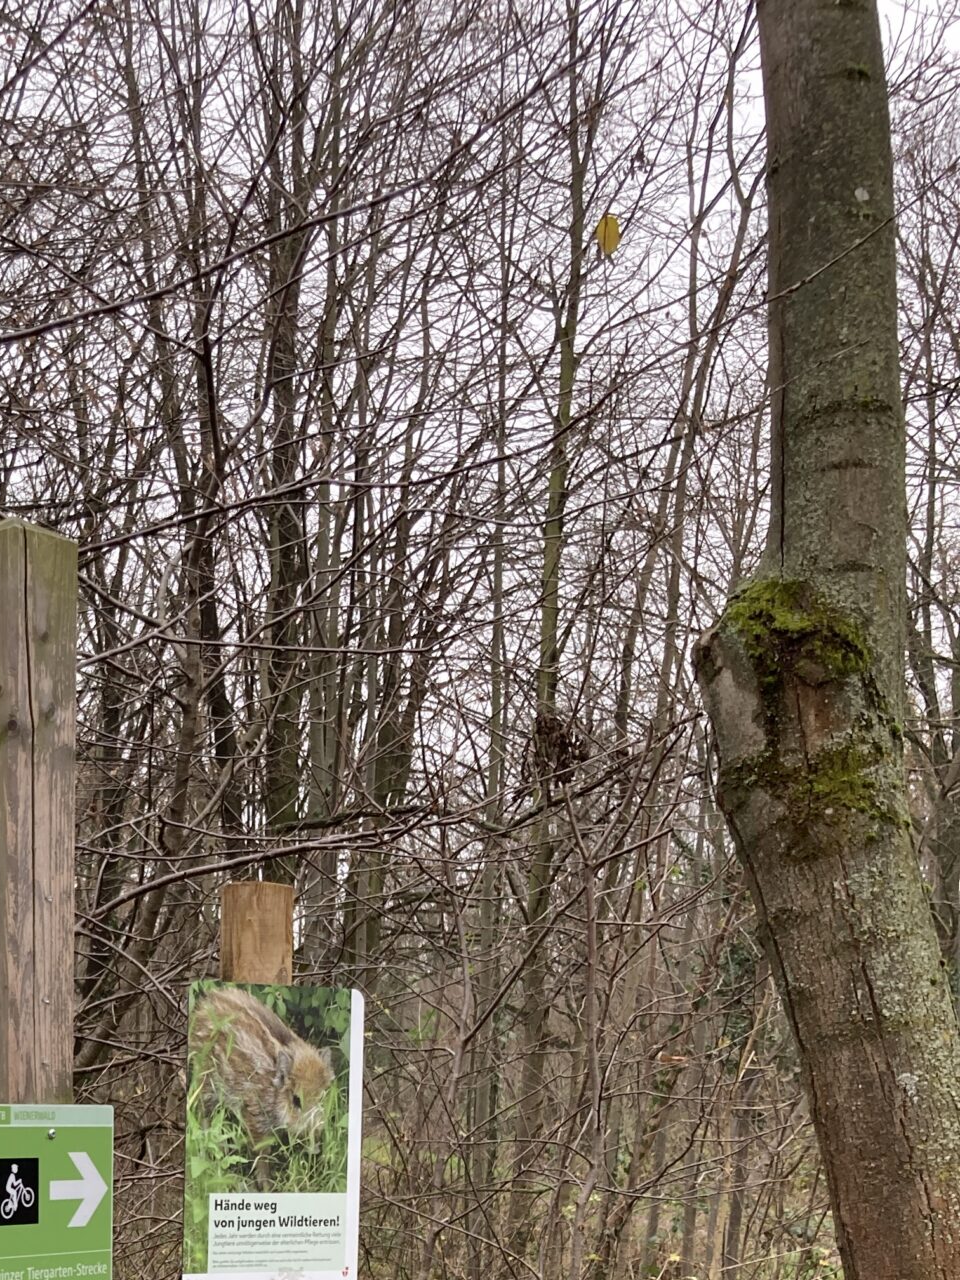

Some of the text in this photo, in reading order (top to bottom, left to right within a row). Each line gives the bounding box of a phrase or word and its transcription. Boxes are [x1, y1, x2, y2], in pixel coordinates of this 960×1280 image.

[214, 1199, 277, 1213] Hände weg
[214, 1216, 340, 1231] von jungen Wildtieren!
